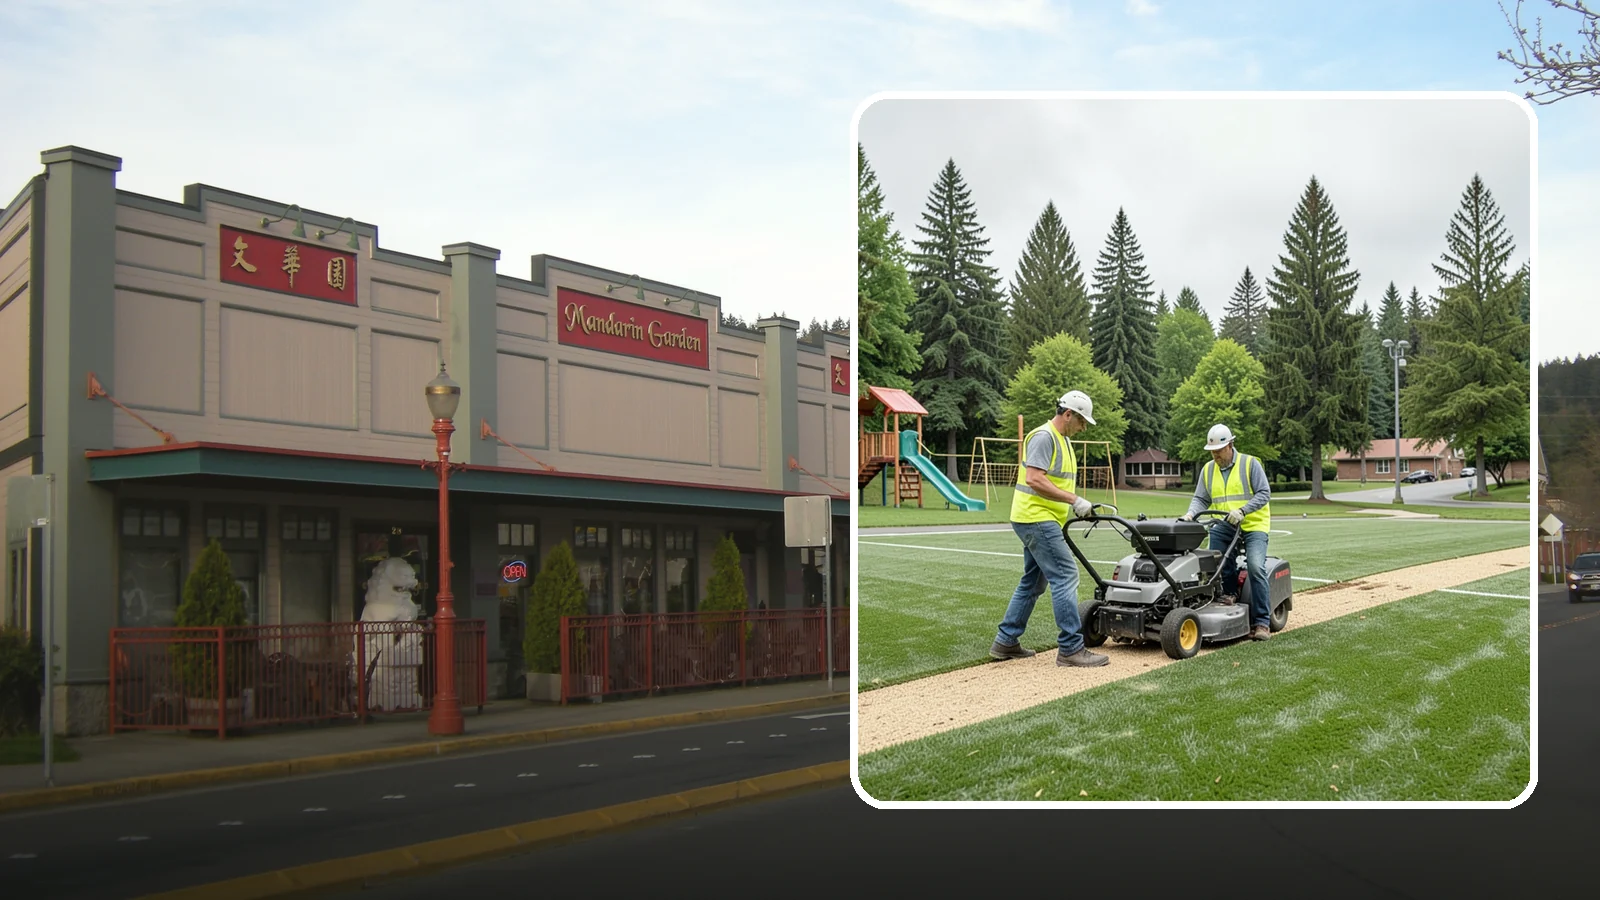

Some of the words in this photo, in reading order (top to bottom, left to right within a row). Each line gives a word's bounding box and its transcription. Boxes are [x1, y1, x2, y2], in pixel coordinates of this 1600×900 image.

[230, 235, 346, 291] 文華園
[565, 302, 644, 341] Mandarin
[647, 320, 702, 352] Garden
[503, 565, 527, 578] OPEN
